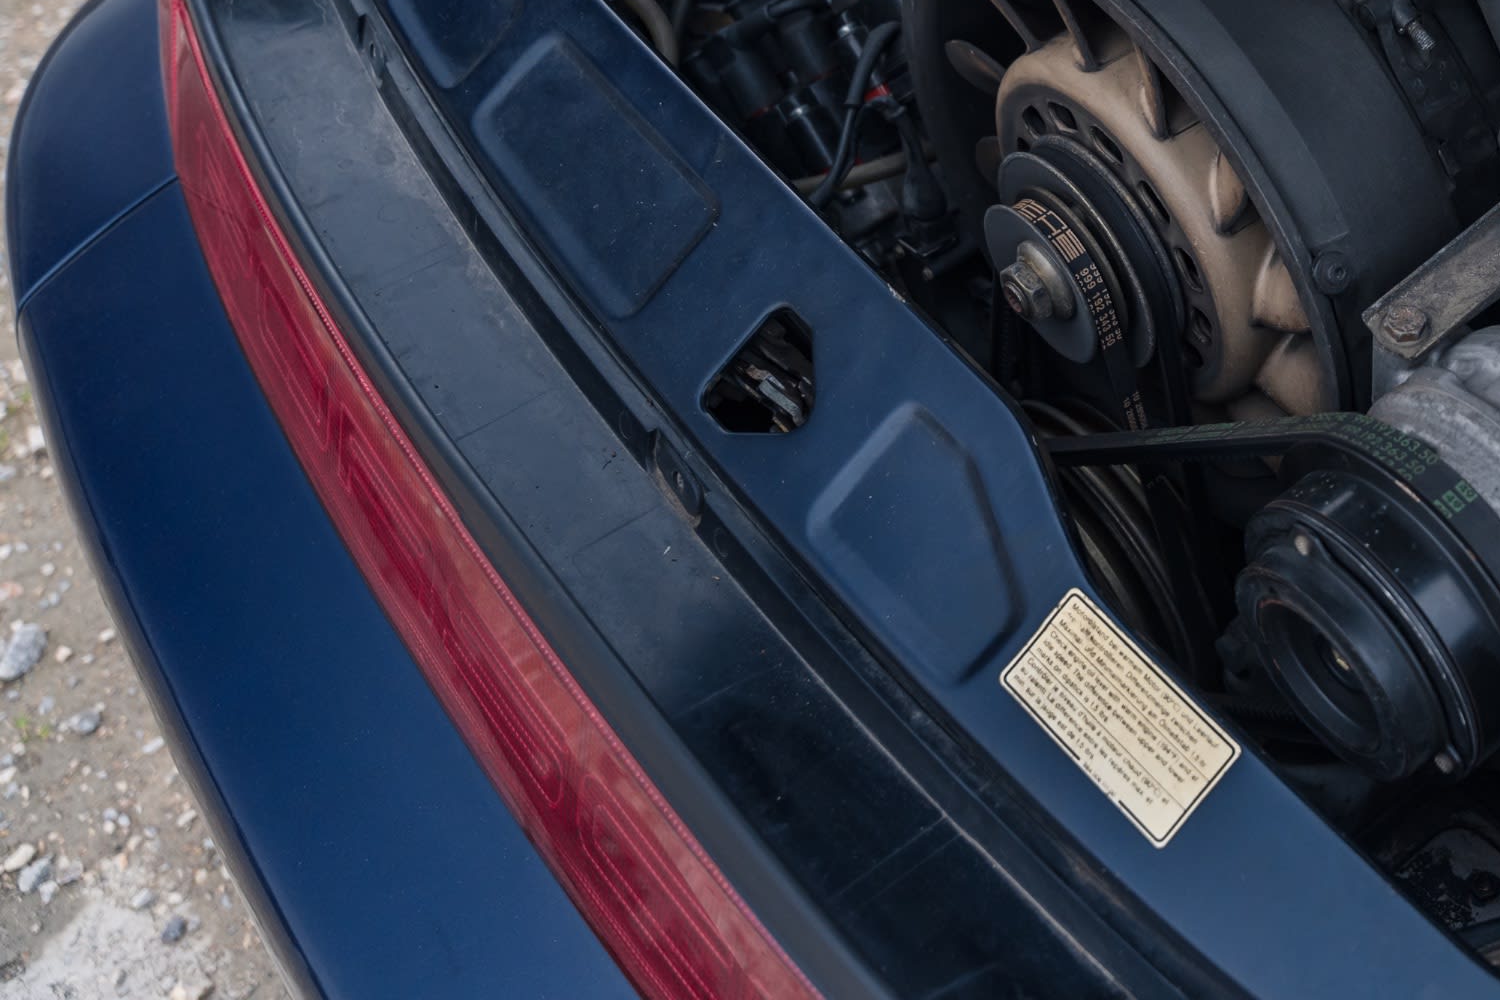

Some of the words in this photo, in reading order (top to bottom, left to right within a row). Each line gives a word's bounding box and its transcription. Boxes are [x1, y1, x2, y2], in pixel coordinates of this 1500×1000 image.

[1080, 266, 1096, 289] 999
[1093, 292, 1105, 312] 192
[1105, 333, 1115, 346] 50
